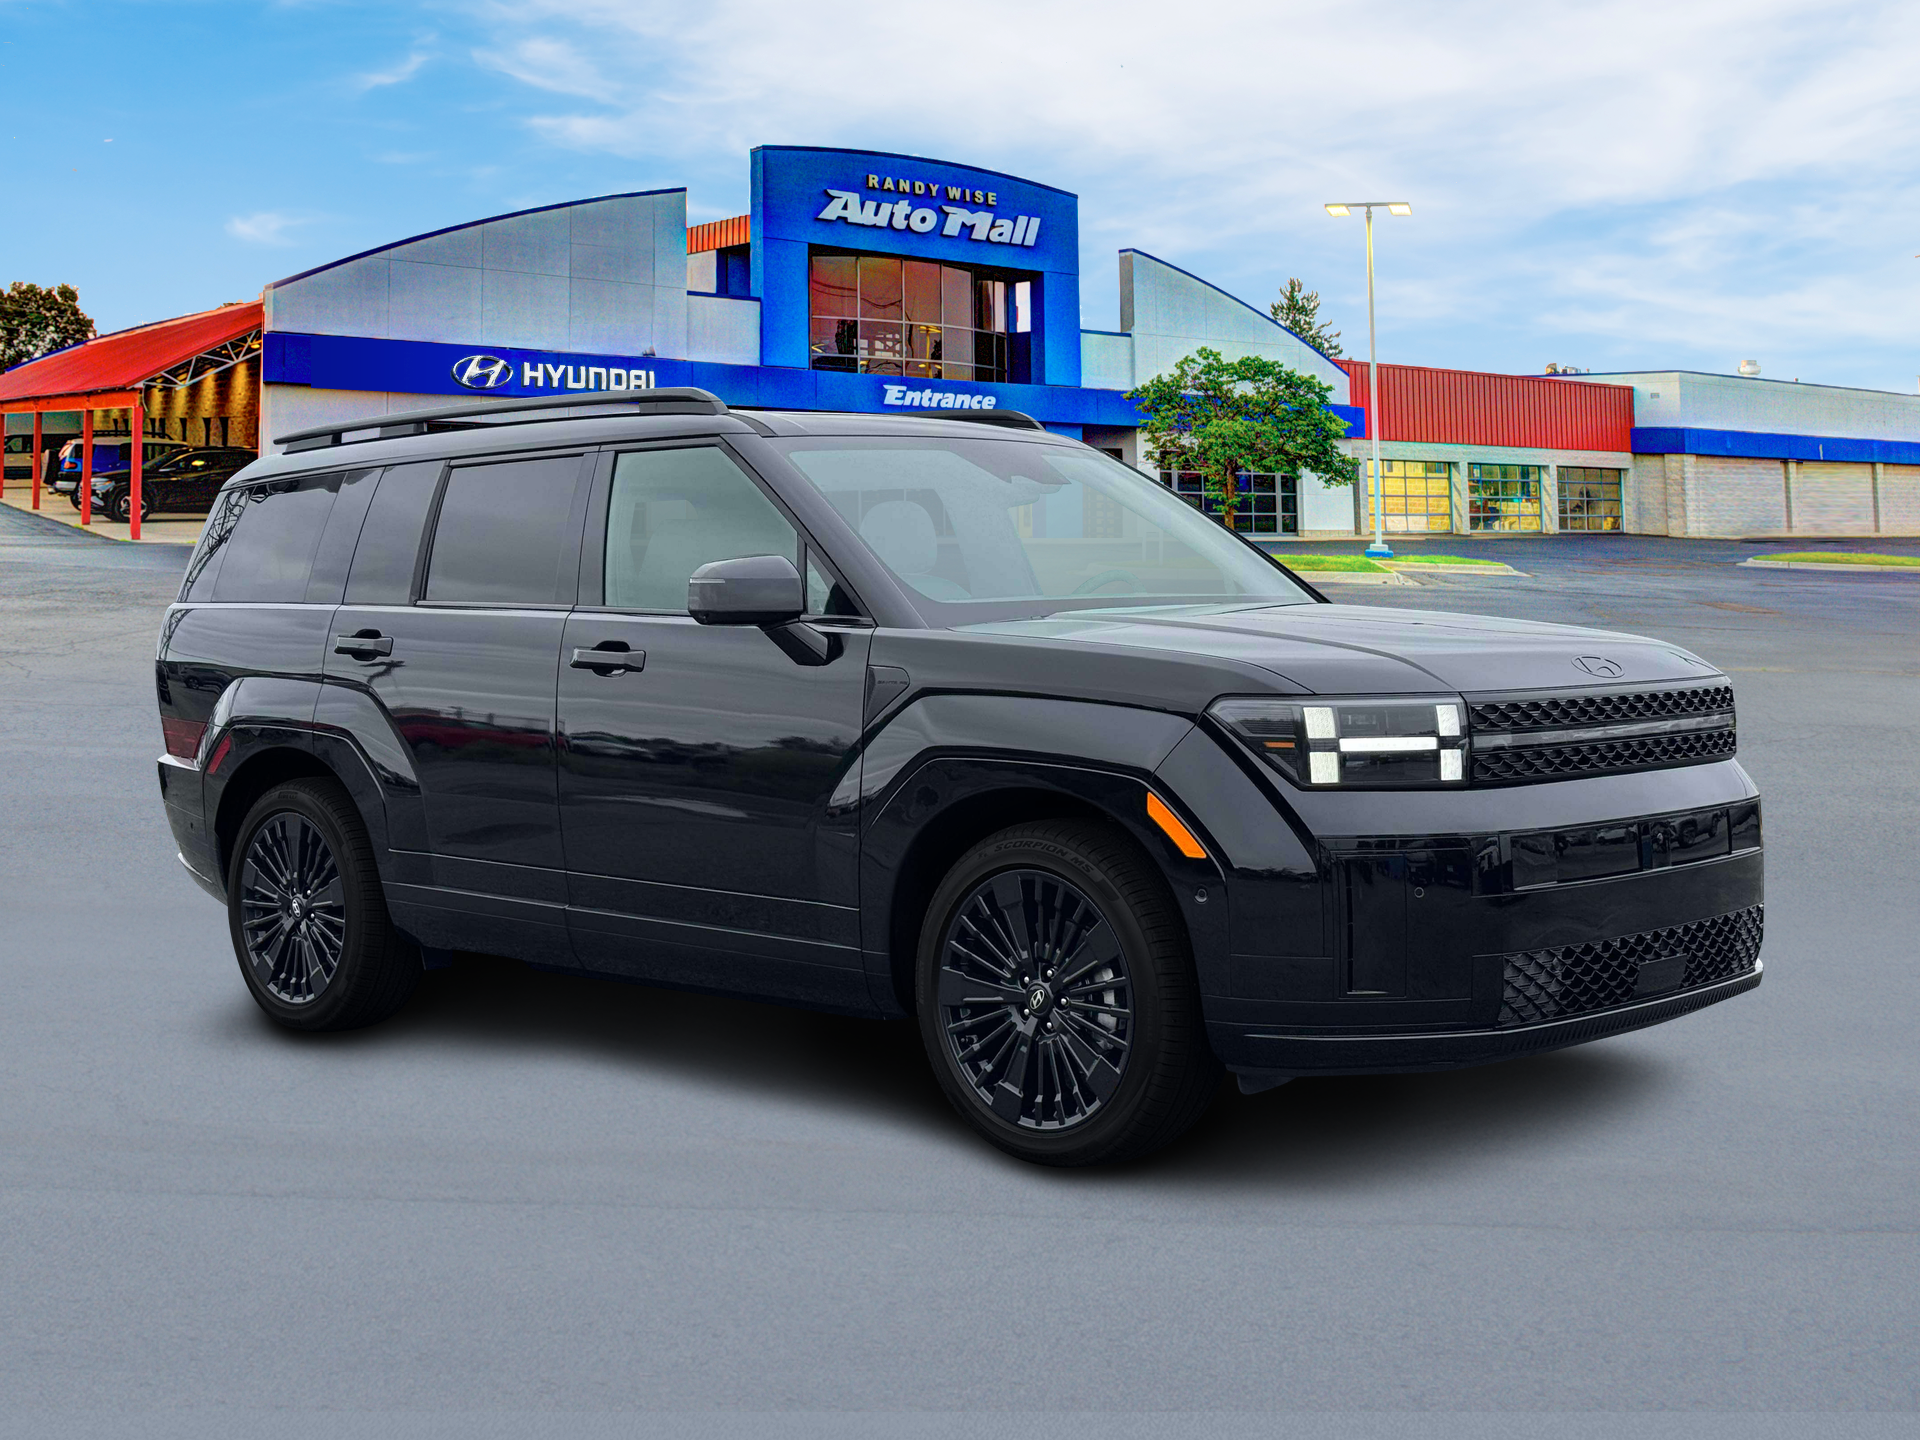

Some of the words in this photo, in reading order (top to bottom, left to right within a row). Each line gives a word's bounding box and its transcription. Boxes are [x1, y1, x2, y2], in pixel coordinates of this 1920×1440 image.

[867, 174, 940, 197] RANDY
[947, 185, 998, 206] WISE
[817, 188, 938, 233] Auto
[941, 204, 1042, 247] Mall
[522, 361, 657, 391] HYUNDAI
[882, 384, 997, 410] Entrance
[993, 839, 1068, 858] SCORPION
[1070, 856, 1095, 874] MS
